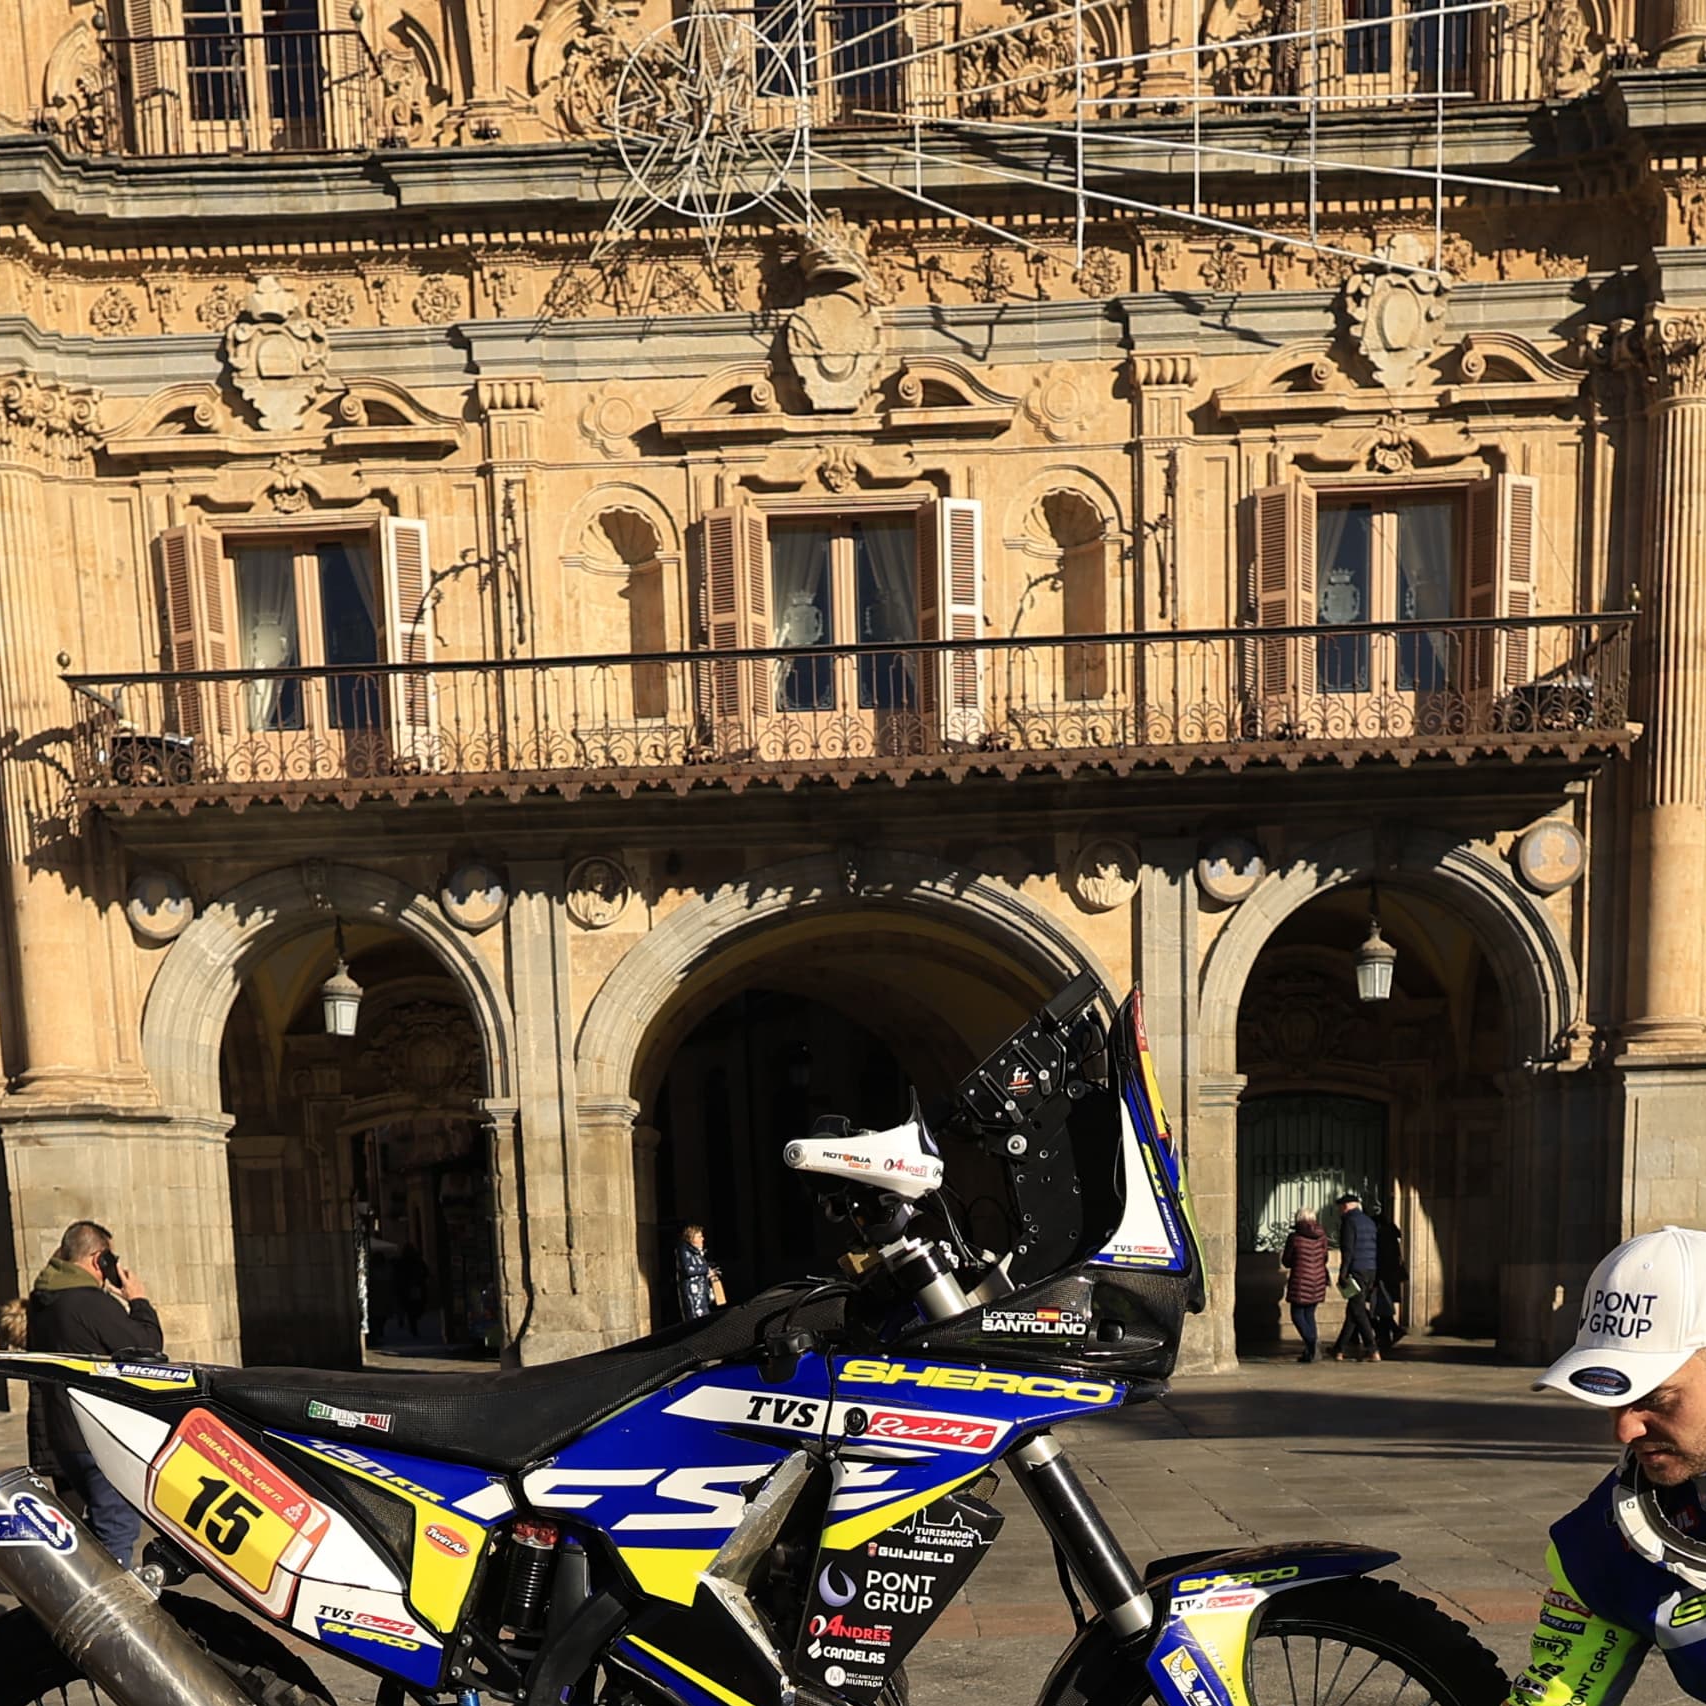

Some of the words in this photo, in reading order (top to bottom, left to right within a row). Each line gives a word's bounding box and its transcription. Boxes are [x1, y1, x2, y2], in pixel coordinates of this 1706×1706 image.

[982, 1307, 1035, 1321] Lorenzo
[1593, 1290, 1658, 1315] PONT
[981, 1319, 1086, 1336] SANTOLINO
[1589, 1313, 1653, 1339] GRUP
[121, 1366, 190, 1381] MICHELIN
[838, 1360, 1117, 1405] SHERCO
[746, 1395, 819, 1428] TVS
[868, 1416, 993, 1445] Racing
[197, 1432, 229, 1460] DREAM.
[229, 1457, 255, 1480] DARE.
[253, 1478, 274, 1496] LIVE
[18, 1502, 63, 1547] TERMIGNONI
[183, 1475, 264, 1556] 15
[427, 1526, 452, 1546] Twin
[449, 1541, 469, 1556] Air
[914, 1535, 974, 1548] SALAMANCA
[915, 1527, 975, 1541] TURISMOde
[878, 1547, 955, 1564] GUIJUELO
[866, 1570, 936, 1594] PONT
[1178, 1566, 1300, 1592] SHERCO
[318, 1604, 354, 1621] TVS
[864, 1592, 933, 1615] GRUP
[321, 1621, 421, 1652] SHERCO
[823, 1646, 886, 1665] CANDELAS
[1589, 1629, 1620, 1673] GRUP
